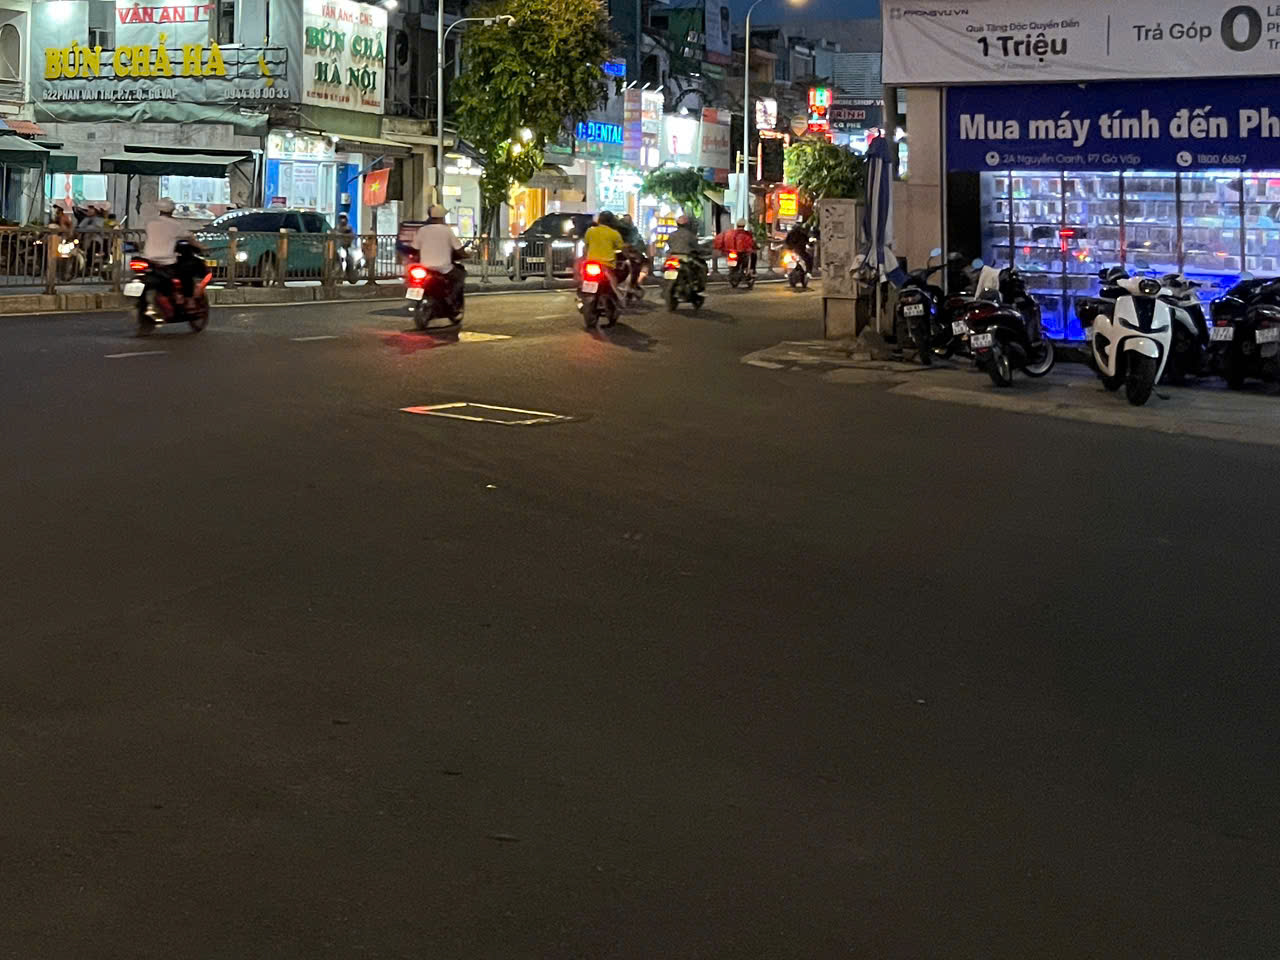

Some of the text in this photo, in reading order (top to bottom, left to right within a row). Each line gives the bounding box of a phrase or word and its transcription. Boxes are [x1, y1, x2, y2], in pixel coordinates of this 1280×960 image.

[304, 22, 385, 60] BÚN CHẢ
[977, 32, 1068, 63] 1 Triệu
[1132, 5, 1263, 52] Trả Góp 0
[44, 32, 227, 80] BÚN CHẢ HÀ
[345, 63, 377, 96] NỘI
[588, 121, 624, 144] DENTAL
[959, 113, 1020, 140] Mua
[1028, 110, 1091, 147] máy
[1099, 109, 1159, 139] tính
[1170, 105, 1228, 138] đến
